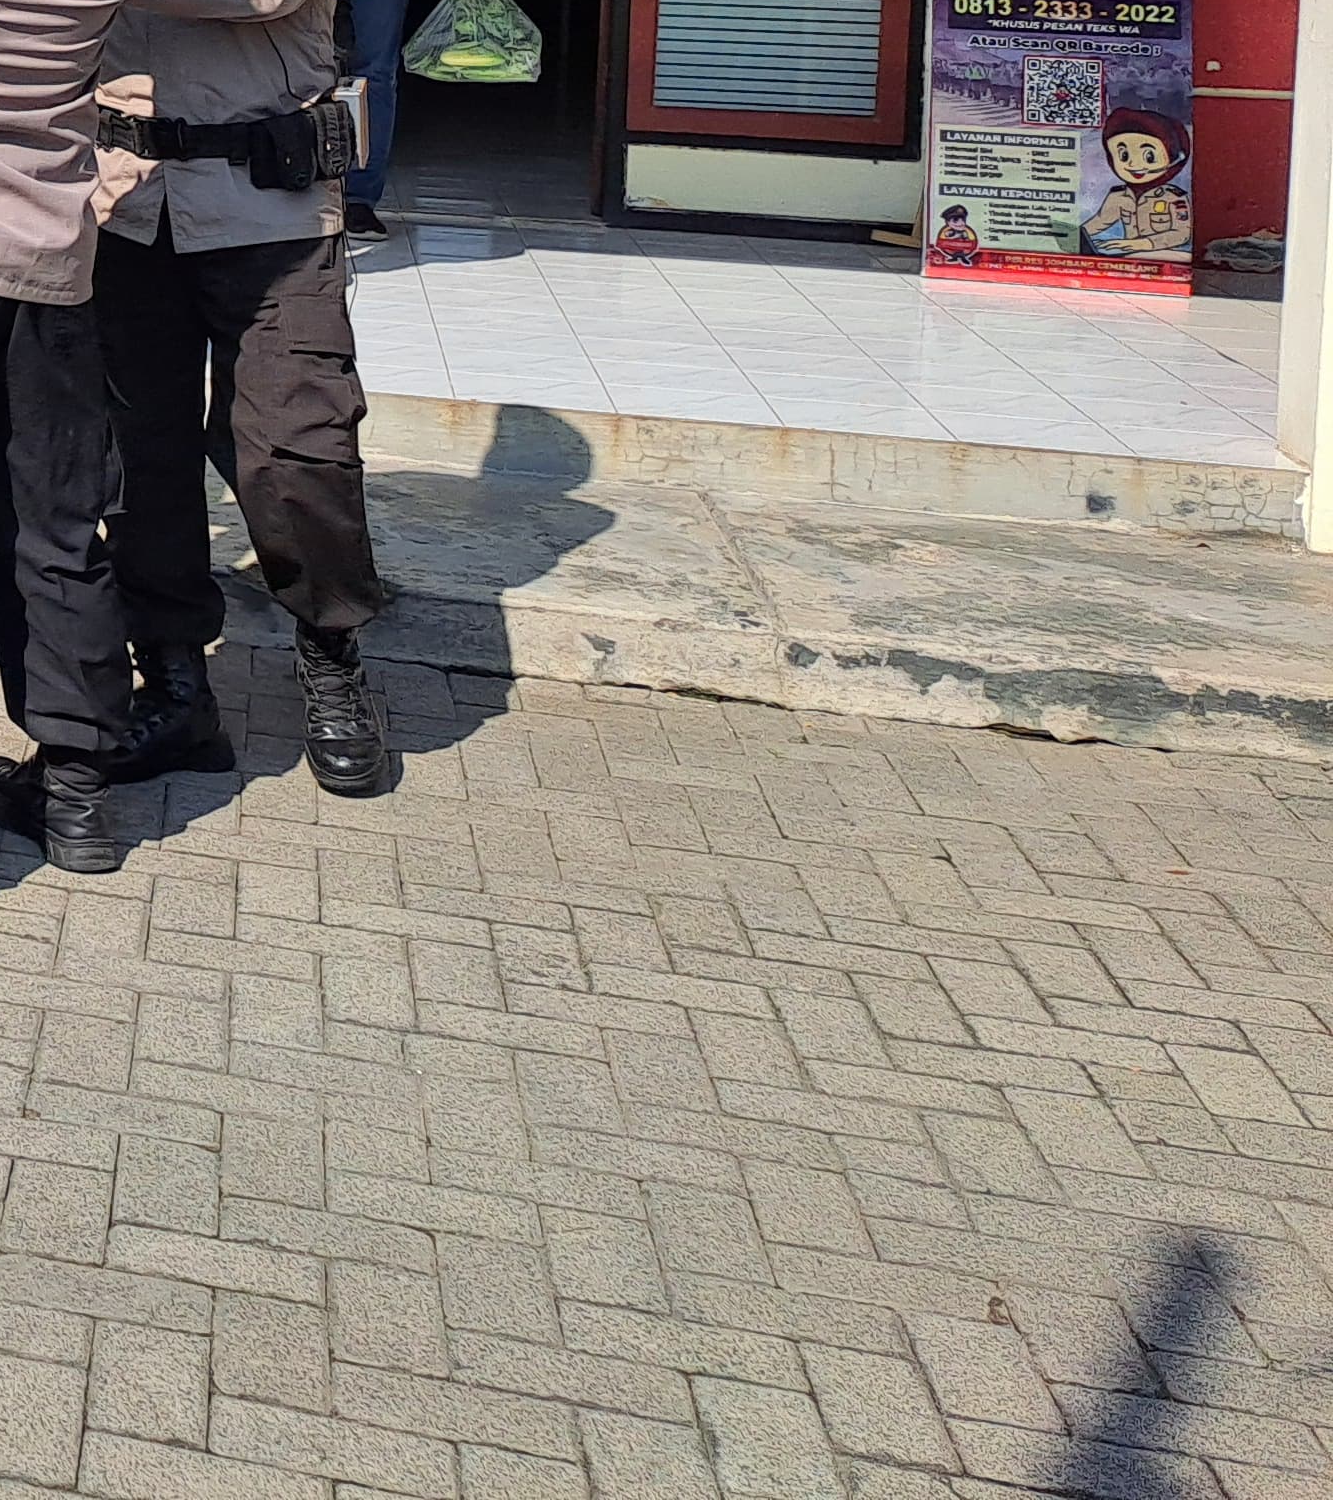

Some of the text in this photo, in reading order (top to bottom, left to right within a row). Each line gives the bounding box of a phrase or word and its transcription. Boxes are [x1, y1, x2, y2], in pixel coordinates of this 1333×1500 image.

[1034, 0, 1093, 20] 2333
[1115, 3, 1175, 23] 2022
[1043, 21, 1083, 32] PESAN
[1085, 23, 1117, 33] TEKS
[1119, 25, 1140, 34] WA
[969, 35, 1008, 47] Atau
[1013, 37, 1050, 49] Scan
[1055, 39, 1079, 51] QR
[1083, 41, 1149, 55] Barcode
[946, 132, 1069, 147] LAYANAN INFORMASI
[943, 186, 1070, 201] LAYANAN KEPOLISIAN
